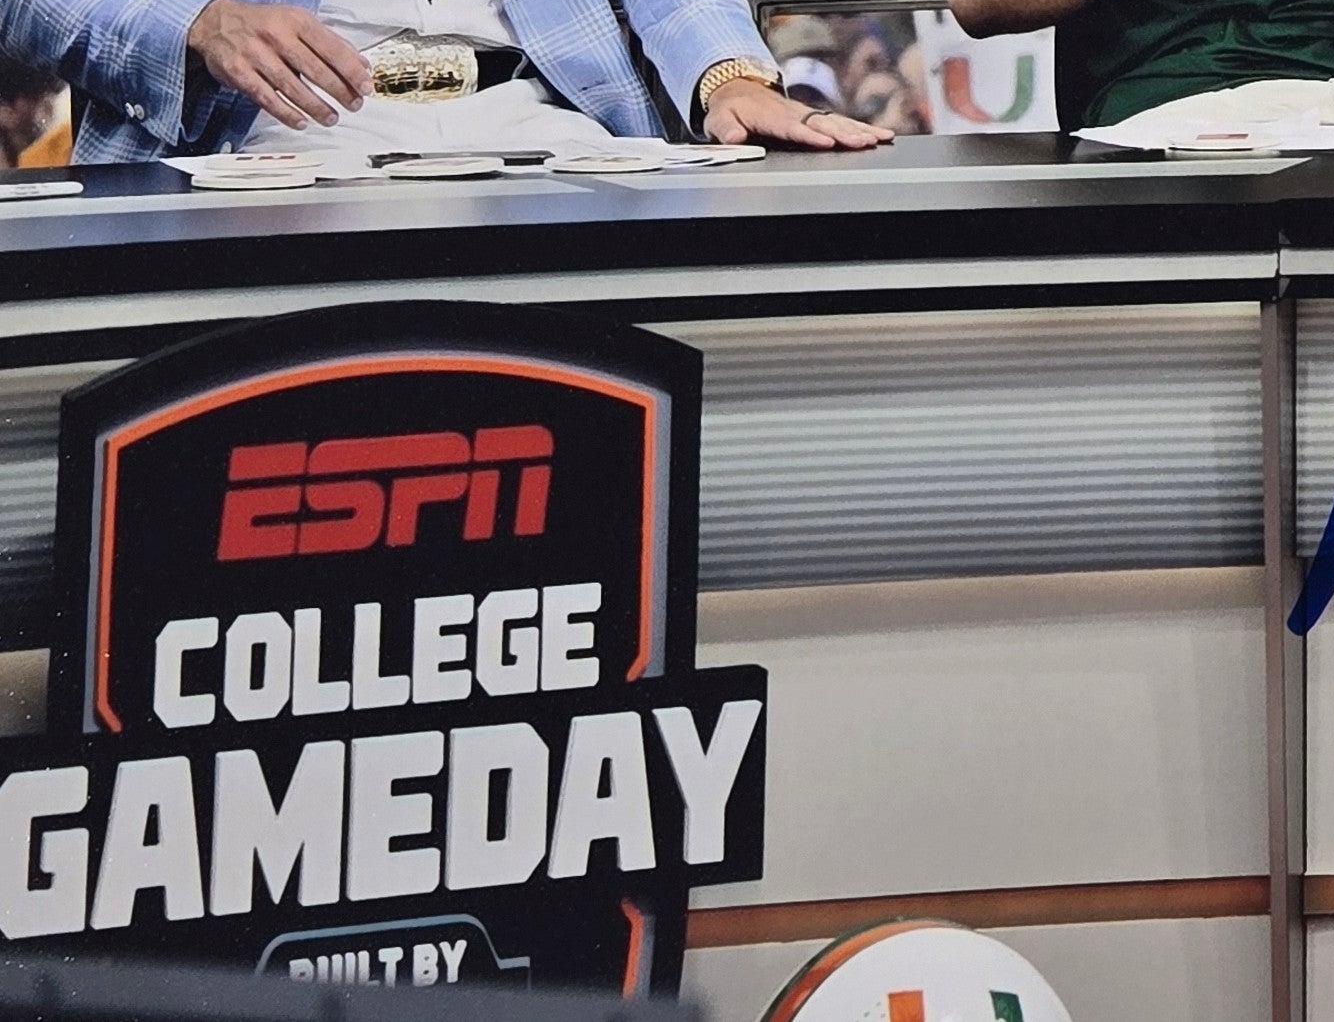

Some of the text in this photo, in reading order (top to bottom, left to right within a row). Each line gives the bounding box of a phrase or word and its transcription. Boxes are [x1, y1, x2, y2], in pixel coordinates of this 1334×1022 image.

[943, 54, 1035, 124] U
[217, 425, 555, 562] ESPN
[153, 582, 602, 728] COLLEGE
[0, 699, 763, 939] GAMEDAY
[412, 939, 468, 987] BY
